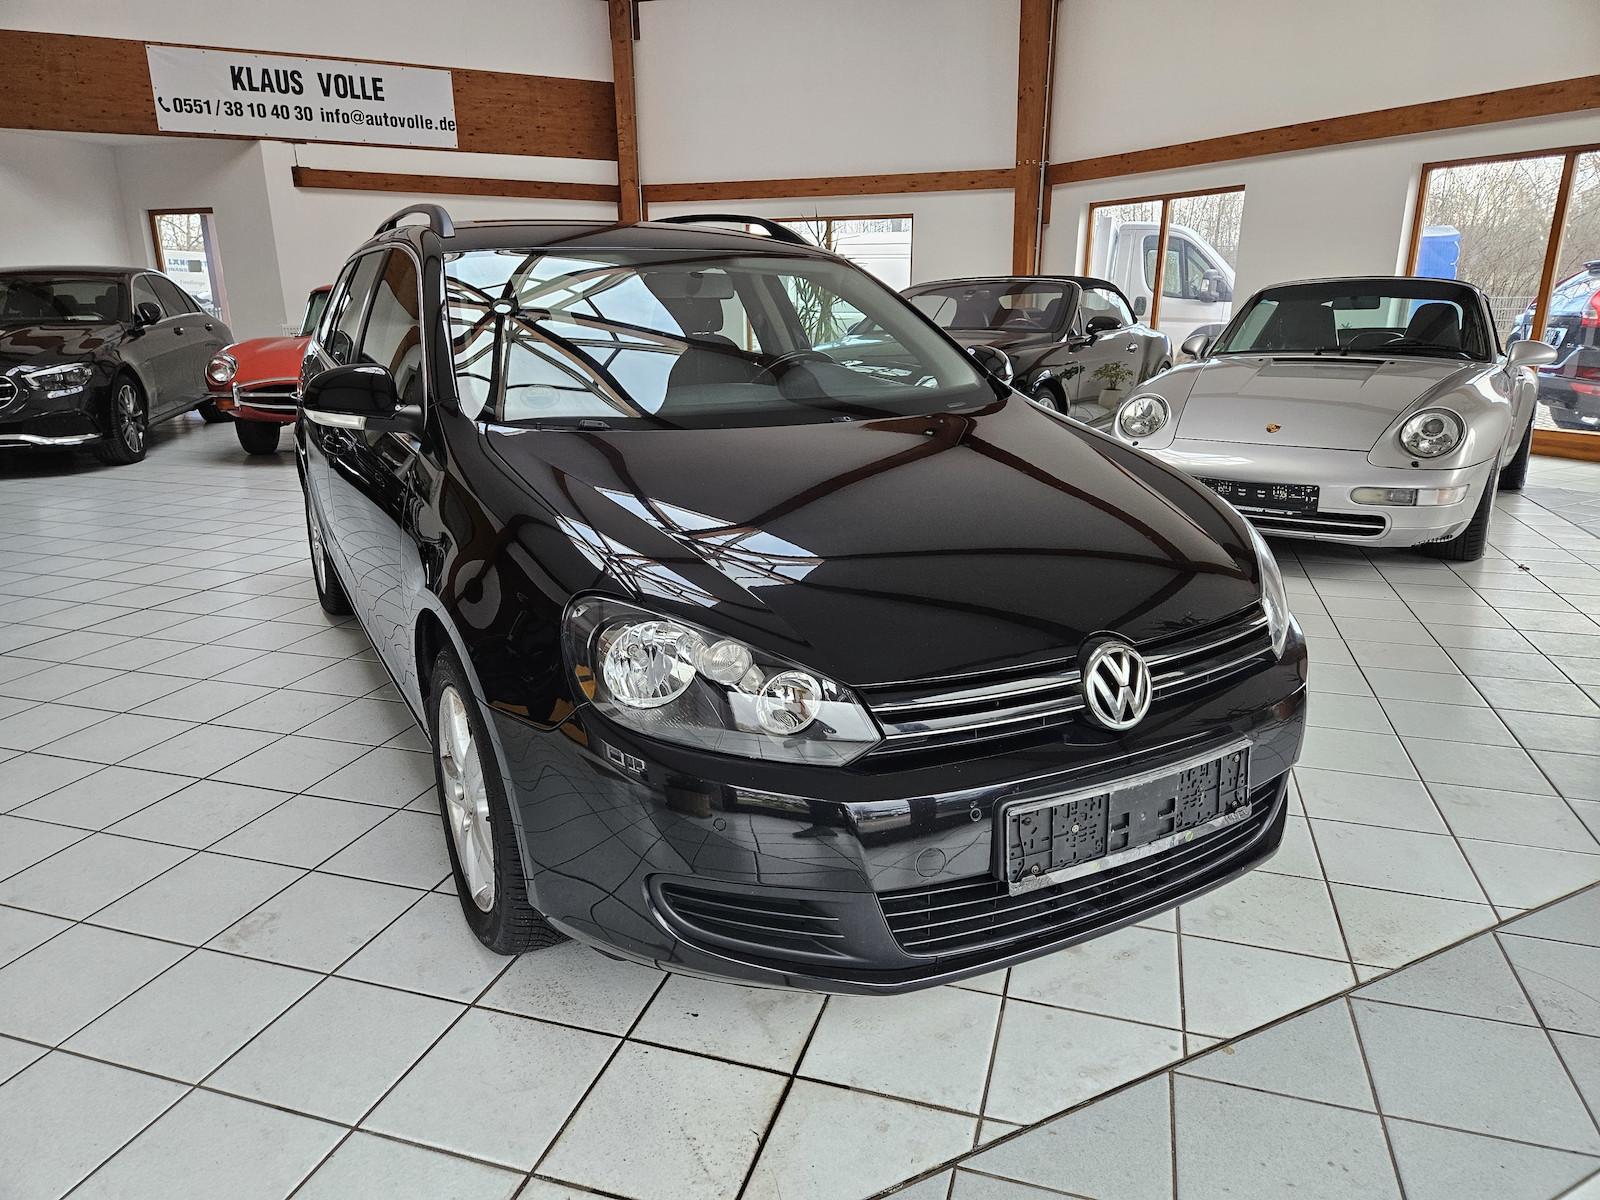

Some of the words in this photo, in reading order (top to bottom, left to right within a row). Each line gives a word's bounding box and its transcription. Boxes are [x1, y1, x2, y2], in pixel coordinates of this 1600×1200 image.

[229, 65, 304, 95] KLAUS
[316, 72, 385, 102] VOLLE
[223, 101, 244, 117] 38
[247, 102, 267, 118] 10
[271, 104, 290, 120] 40
[294, 105, 314, 122] 30
[320, 107, 456, 132] info@autovolle.de
